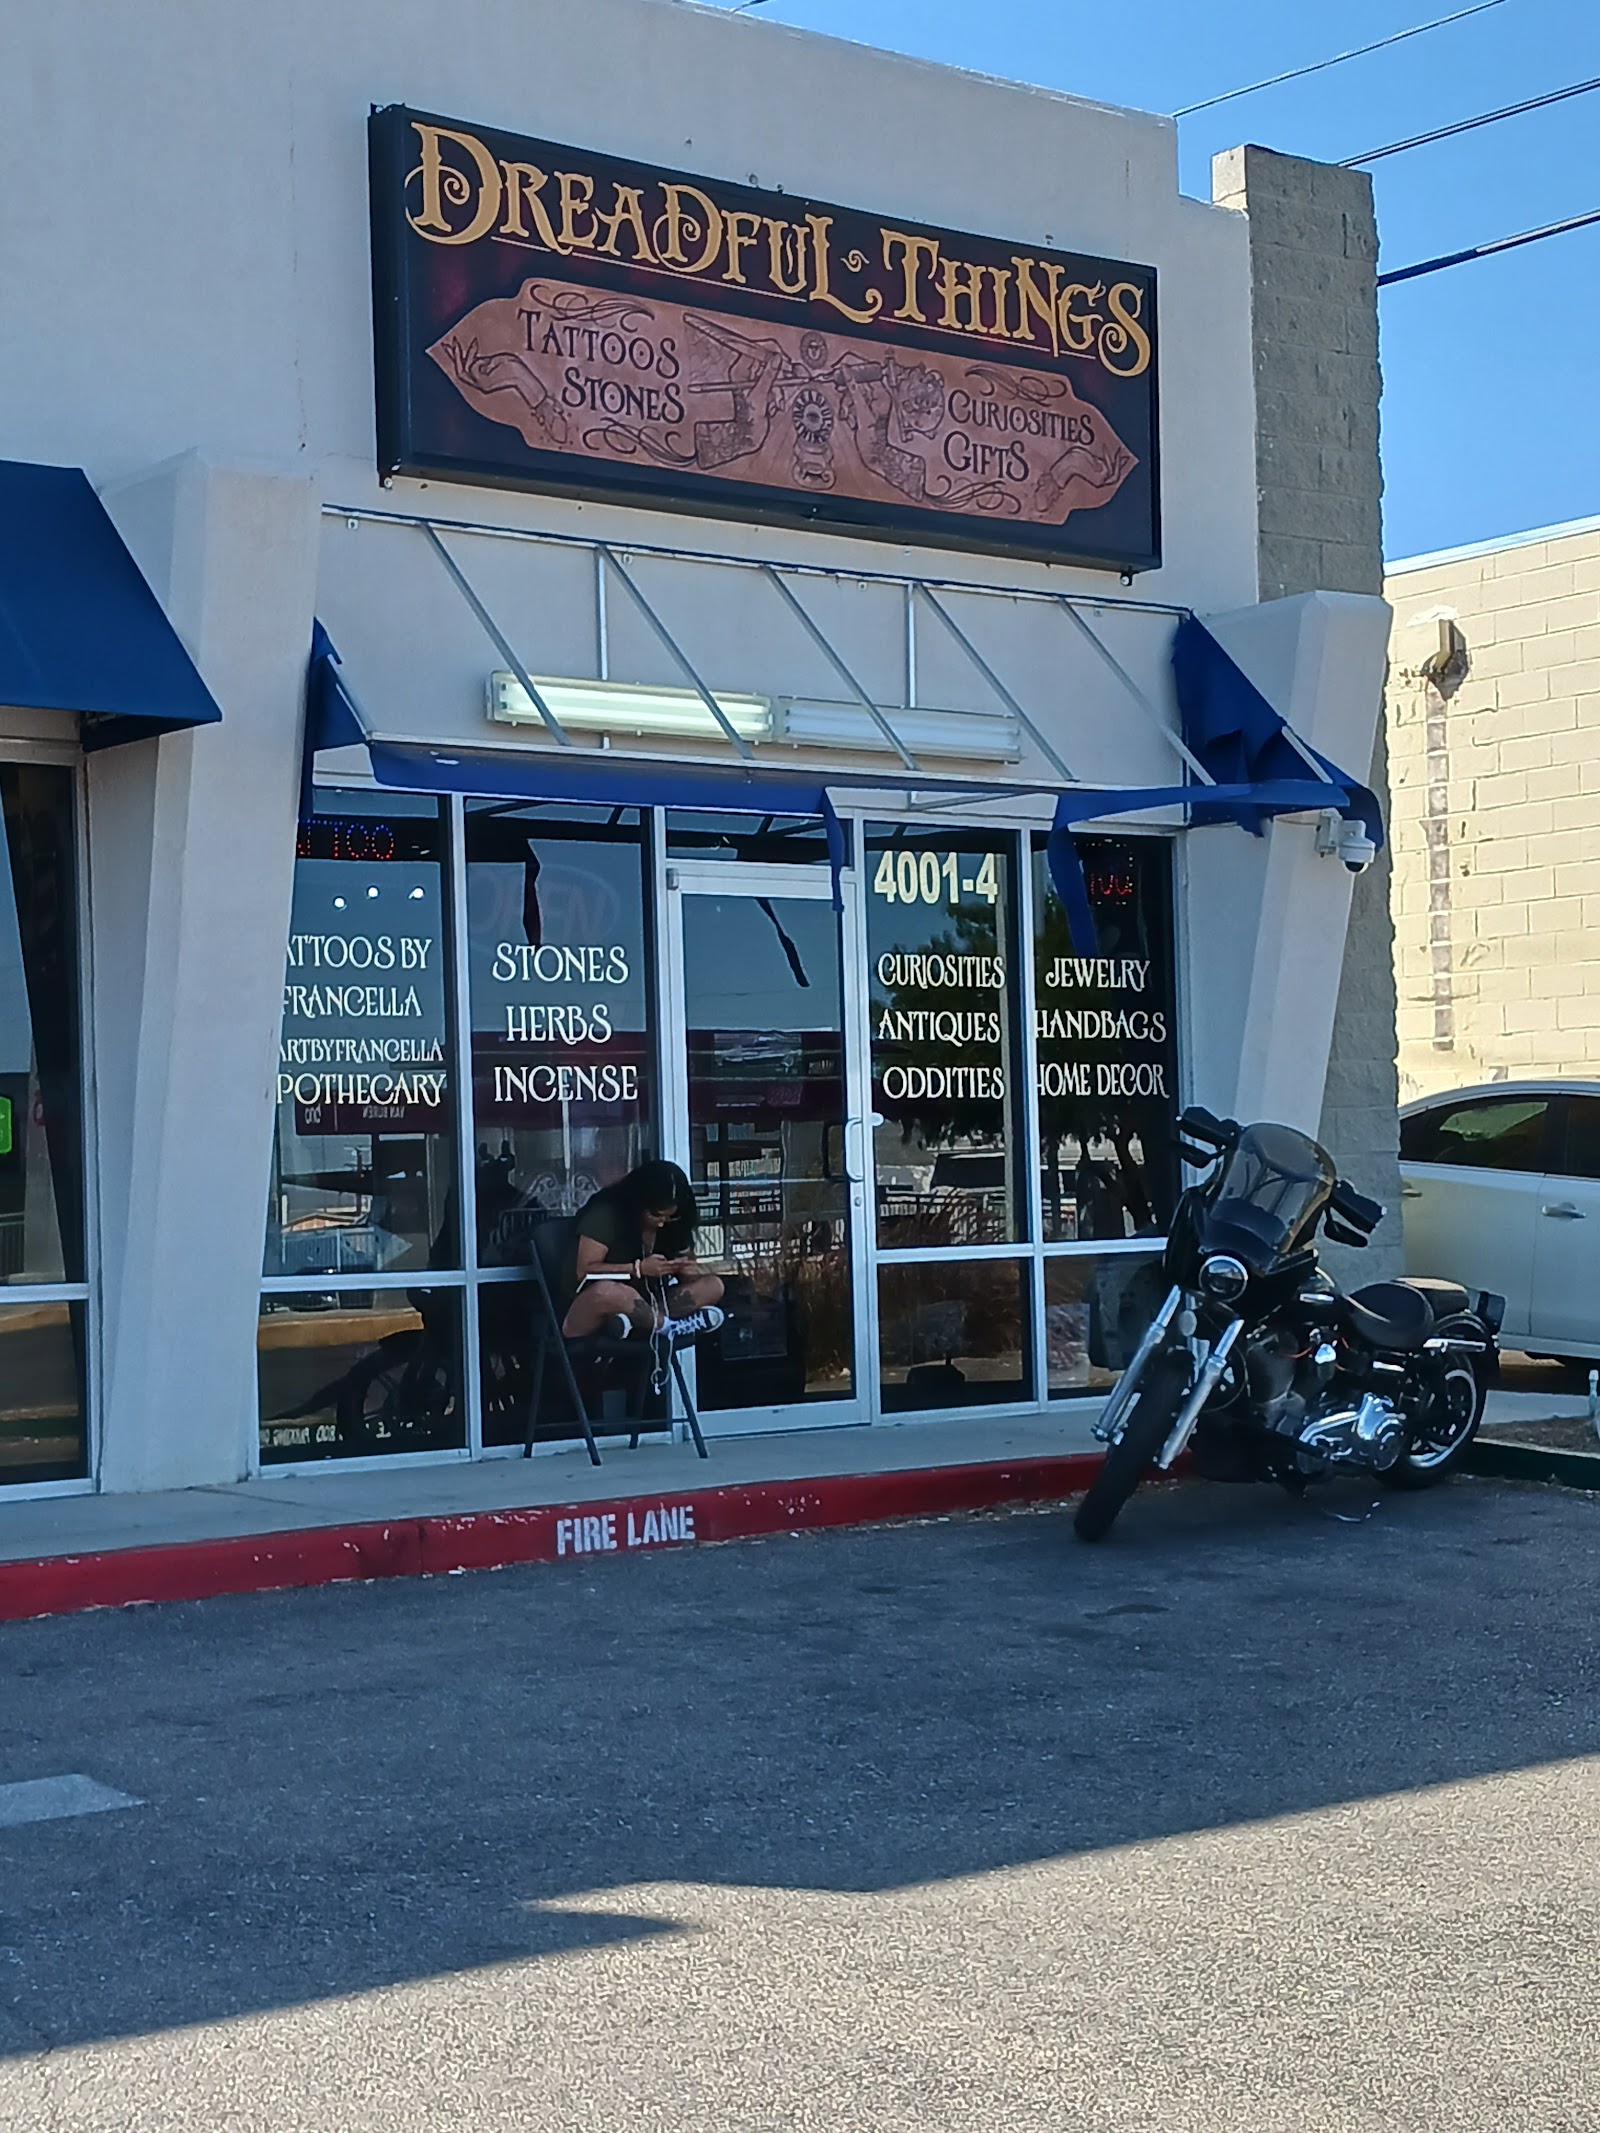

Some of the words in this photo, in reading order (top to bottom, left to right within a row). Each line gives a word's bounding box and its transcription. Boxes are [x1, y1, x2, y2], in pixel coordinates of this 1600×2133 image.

[404, 121, 882, 323] DREADFUL
[880, 228, 1150, 377] THINGS
[517, 308, 680, 379] TATTOOS
[561, 366, 685, 424] STONES
[948, 389, 1095, 446] CURIOSITIES
[944, 430, 1029, 481] GIFTS
[874, 850, 999, 904] 4001-4
[400, 938, 432, 969] BY
[492, 943, 629, 984] STONES
[877, 953, 1006, 990] CURIOSITIES
[1045, 957, 1150, 992] JEWELRY
[506, 1003, 612, 1045] HERBS
[878, 1008, 1001, 1047] ANTIQUES
[1035, 1008, 1167, 1043] HANDBAGS
[494, 1065, 638, 1102] INCENSE
[882, 1066, 1005, 1100] ODDITIES
[1096, 1063, 1170, 1099] DECOR
[557, 1513, 617, 1556] FIRE
[627, 1505, 696, 1547] LANE
